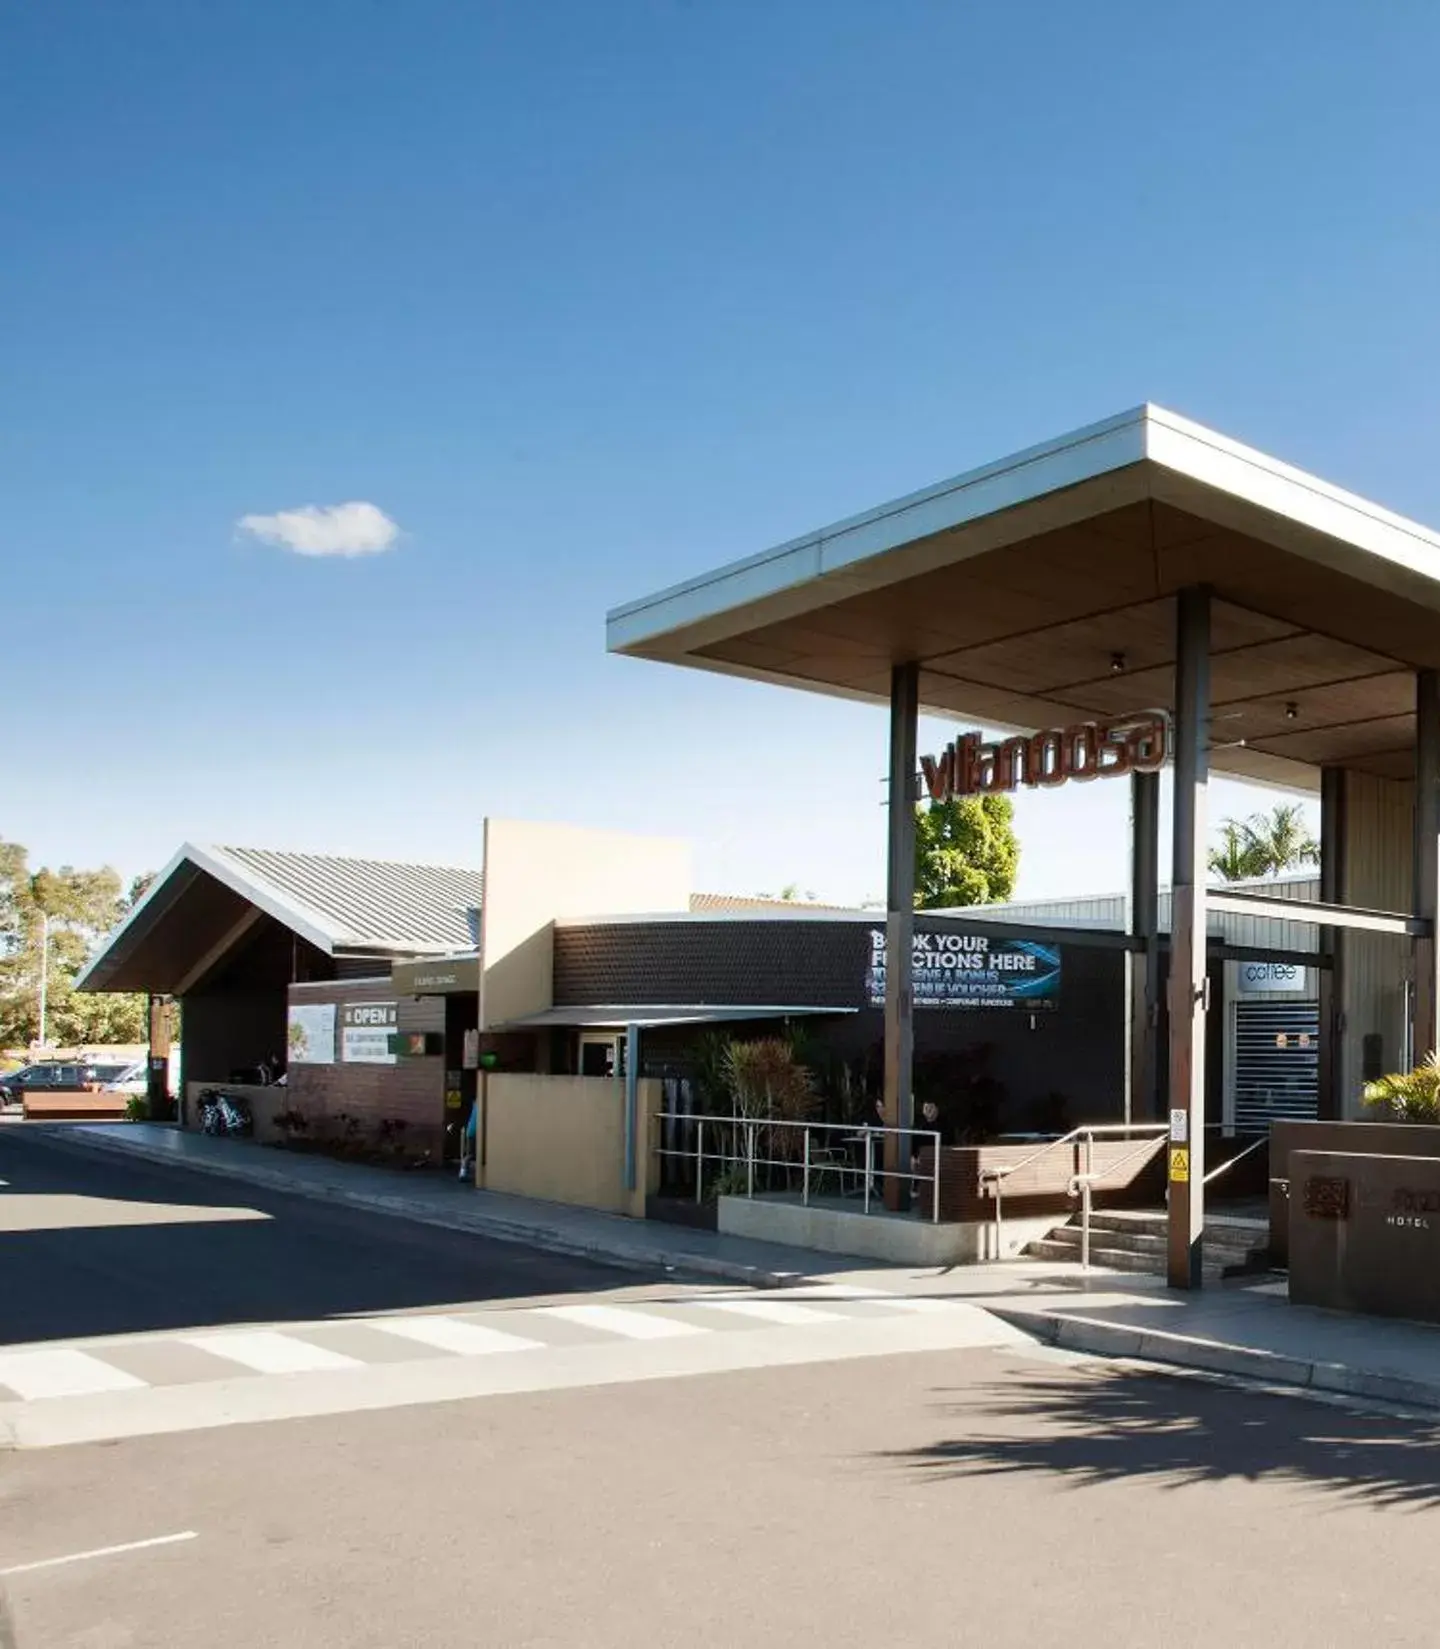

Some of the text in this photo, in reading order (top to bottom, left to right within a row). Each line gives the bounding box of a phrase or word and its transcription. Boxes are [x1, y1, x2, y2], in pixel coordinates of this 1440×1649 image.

[870, 930, 989, 951] BK YOUR
[871, 950, 1036, 971] FCTIONS HERE
[353, 1008, 387, 1024] OPEN
[1387, 1215, 1430, 1229] HOTEL
